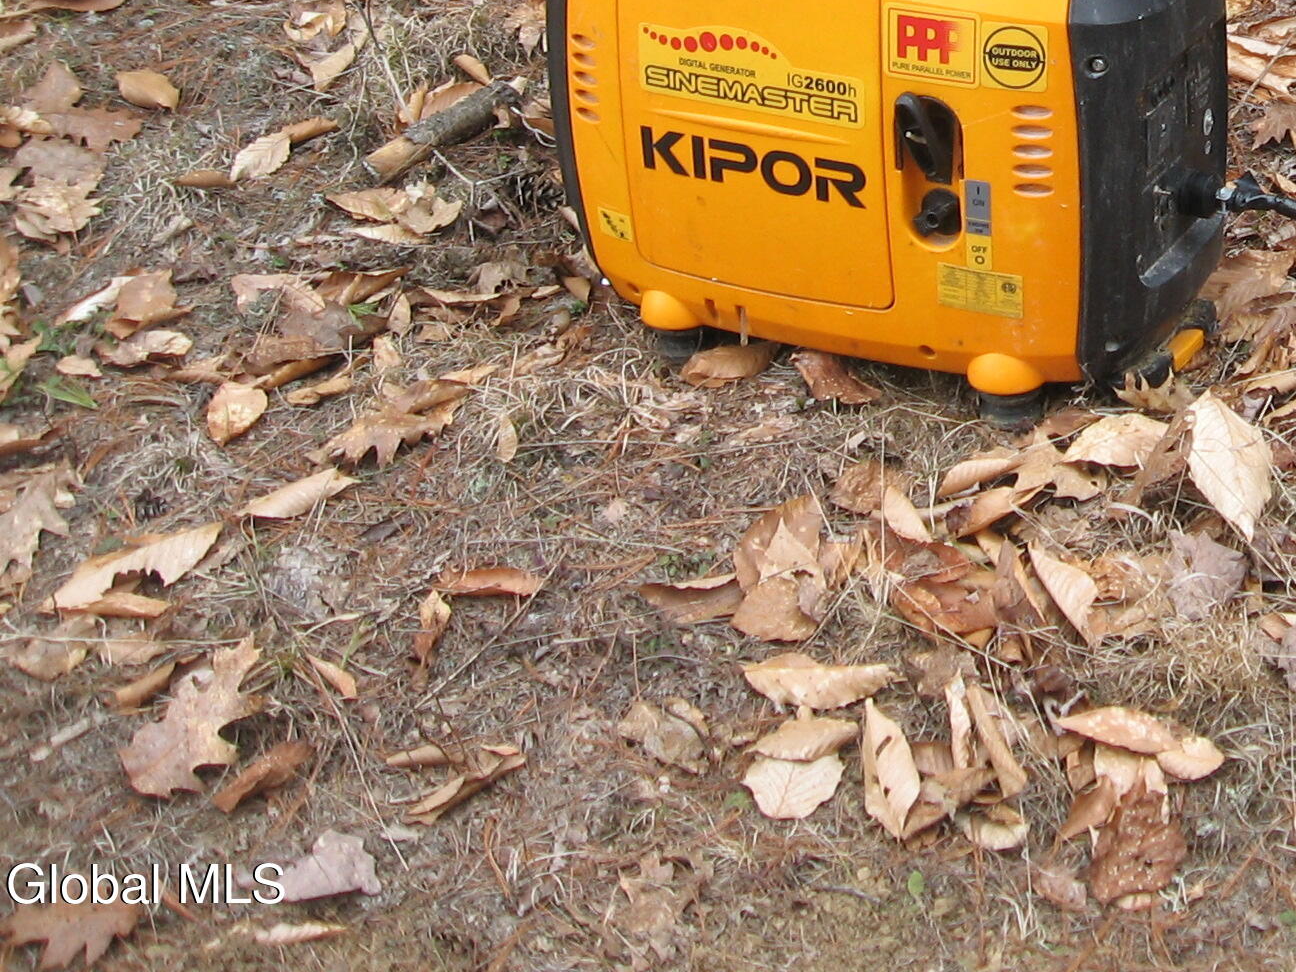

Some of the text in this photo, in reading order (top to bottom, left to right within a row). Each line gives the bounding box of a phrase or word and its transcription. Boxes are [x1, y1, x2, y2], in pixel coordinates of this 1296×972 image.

[991, 46, 1038, 59] OUTDOOR
[678, 57, 756, 78] DIGITAL GENERATOR
[892, 61, 972, 79] PURE PARALLEL POWER
[991, 57, 1038, 69] USE ONLY
[645, 64, 858, 123] SINEMASTER
[640, 125, 867, 209] KIPOR
[971, 245, 987, 253] OFF
